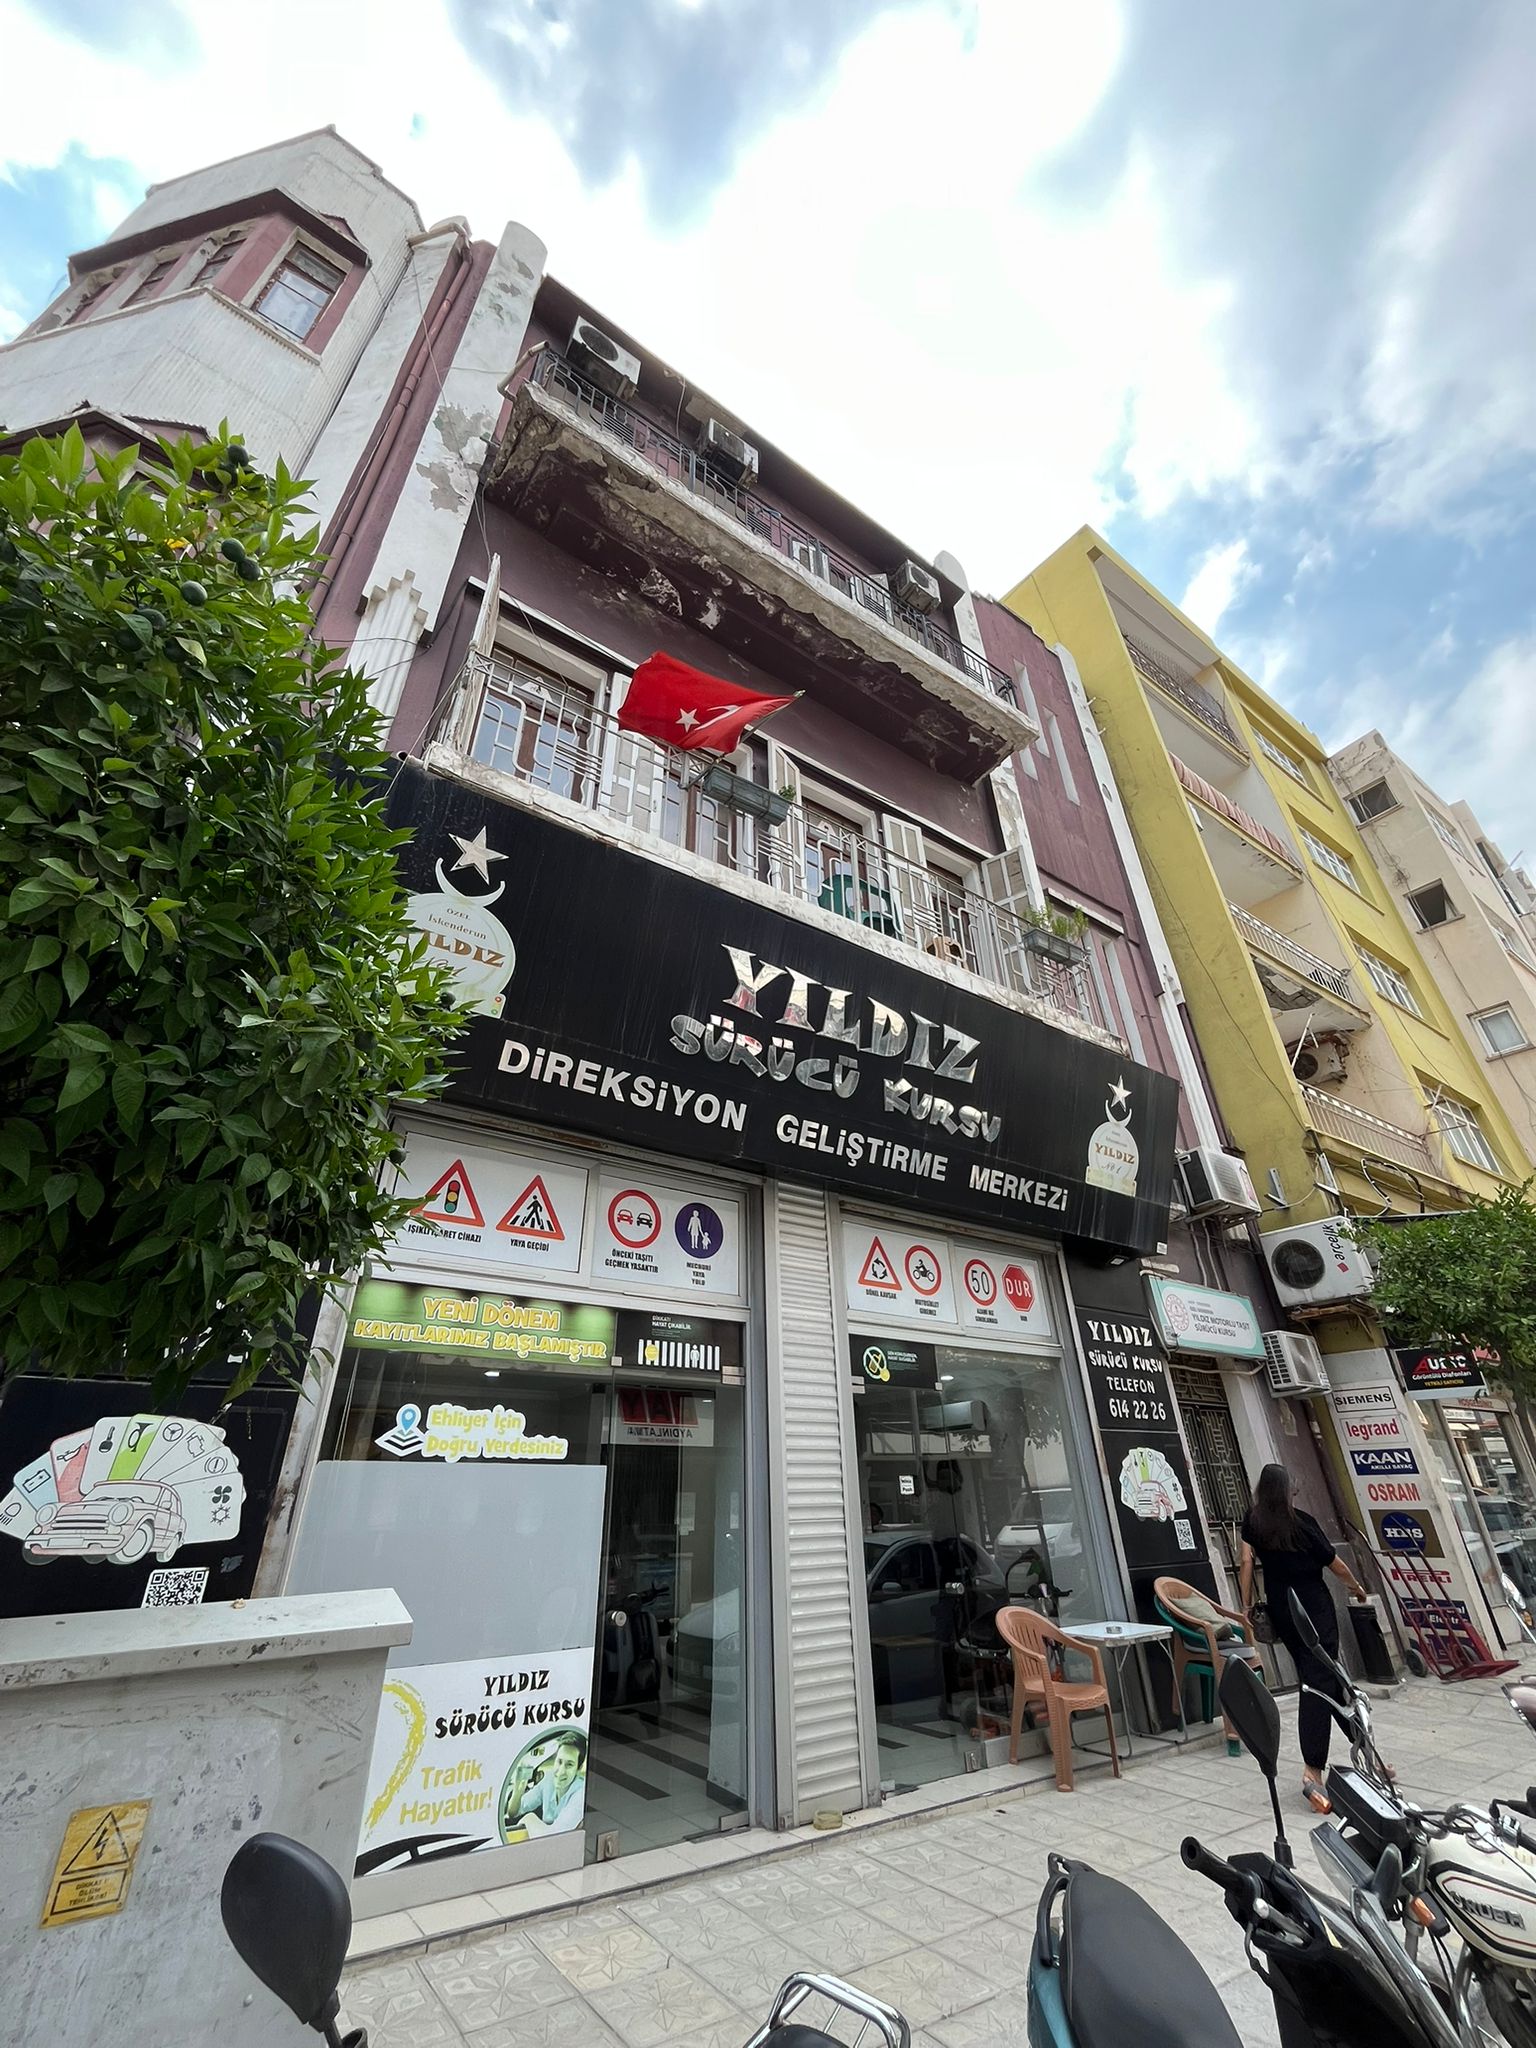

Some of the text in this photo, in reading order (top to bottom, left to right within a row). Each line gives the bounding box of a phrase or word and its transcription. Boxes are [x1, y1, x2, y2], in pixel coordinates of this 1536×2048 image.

[428, 913, 487, 940] İskenderun
[413, 927, 506, 968] ILDIZ
[721, 943, 981, 1084] YILDIZ
[669, 1014, 860, 1098] SÜRÜCÜ
[883, 1077, 1001, 1142] KURSU
[1095, 1143, 1135, 1164] YILDIZ
[457, 1231, 482, 1243] CİHAZI
[510, 1238, 550, 1252] YAYA GEÇİDİ
[605, 1258, 658, 1273] GEÇMEK YASAKTIR
[971, 1270, 990, 1295] 50
[1005, 1278, 1032, 1298] DUR
[424, 1297, 560, 1331] YENİ DÖNEM
[354, 1320, 607, 1362] KAYITLARIMIZ BAŞLAMIŞTIR
[1086, 1320, 1153, 1347] YILDIZ
[1088, 1349, 1163, 1373] SÜRÜCÜ KURSU
[1106, 1376, 1155, 1394] TELEFON
[1109, 1398, 1166, 1420] 614 22 26
[1334, 1393, 1392, 1406] SIEMENS
[431, 1408, 521, 1435] Ehliyet İçin
[1345, 1418, 1400, 1441] legrand
[426, 1435, 564, 1457] Doğru Yerdesiniz
[1354, 1451, 1411, 1465] KAAN
[1367, 1483, 1420, 1501] OSRAM
[484, 1670, 550, 1697] YILDIZ
[434, 1698, 585, 1738] SÜRÜCÜ KURSU
[421, 1760, 483, 1790] Trafik
[400, 1787, 493, 1825] Hayattır!
